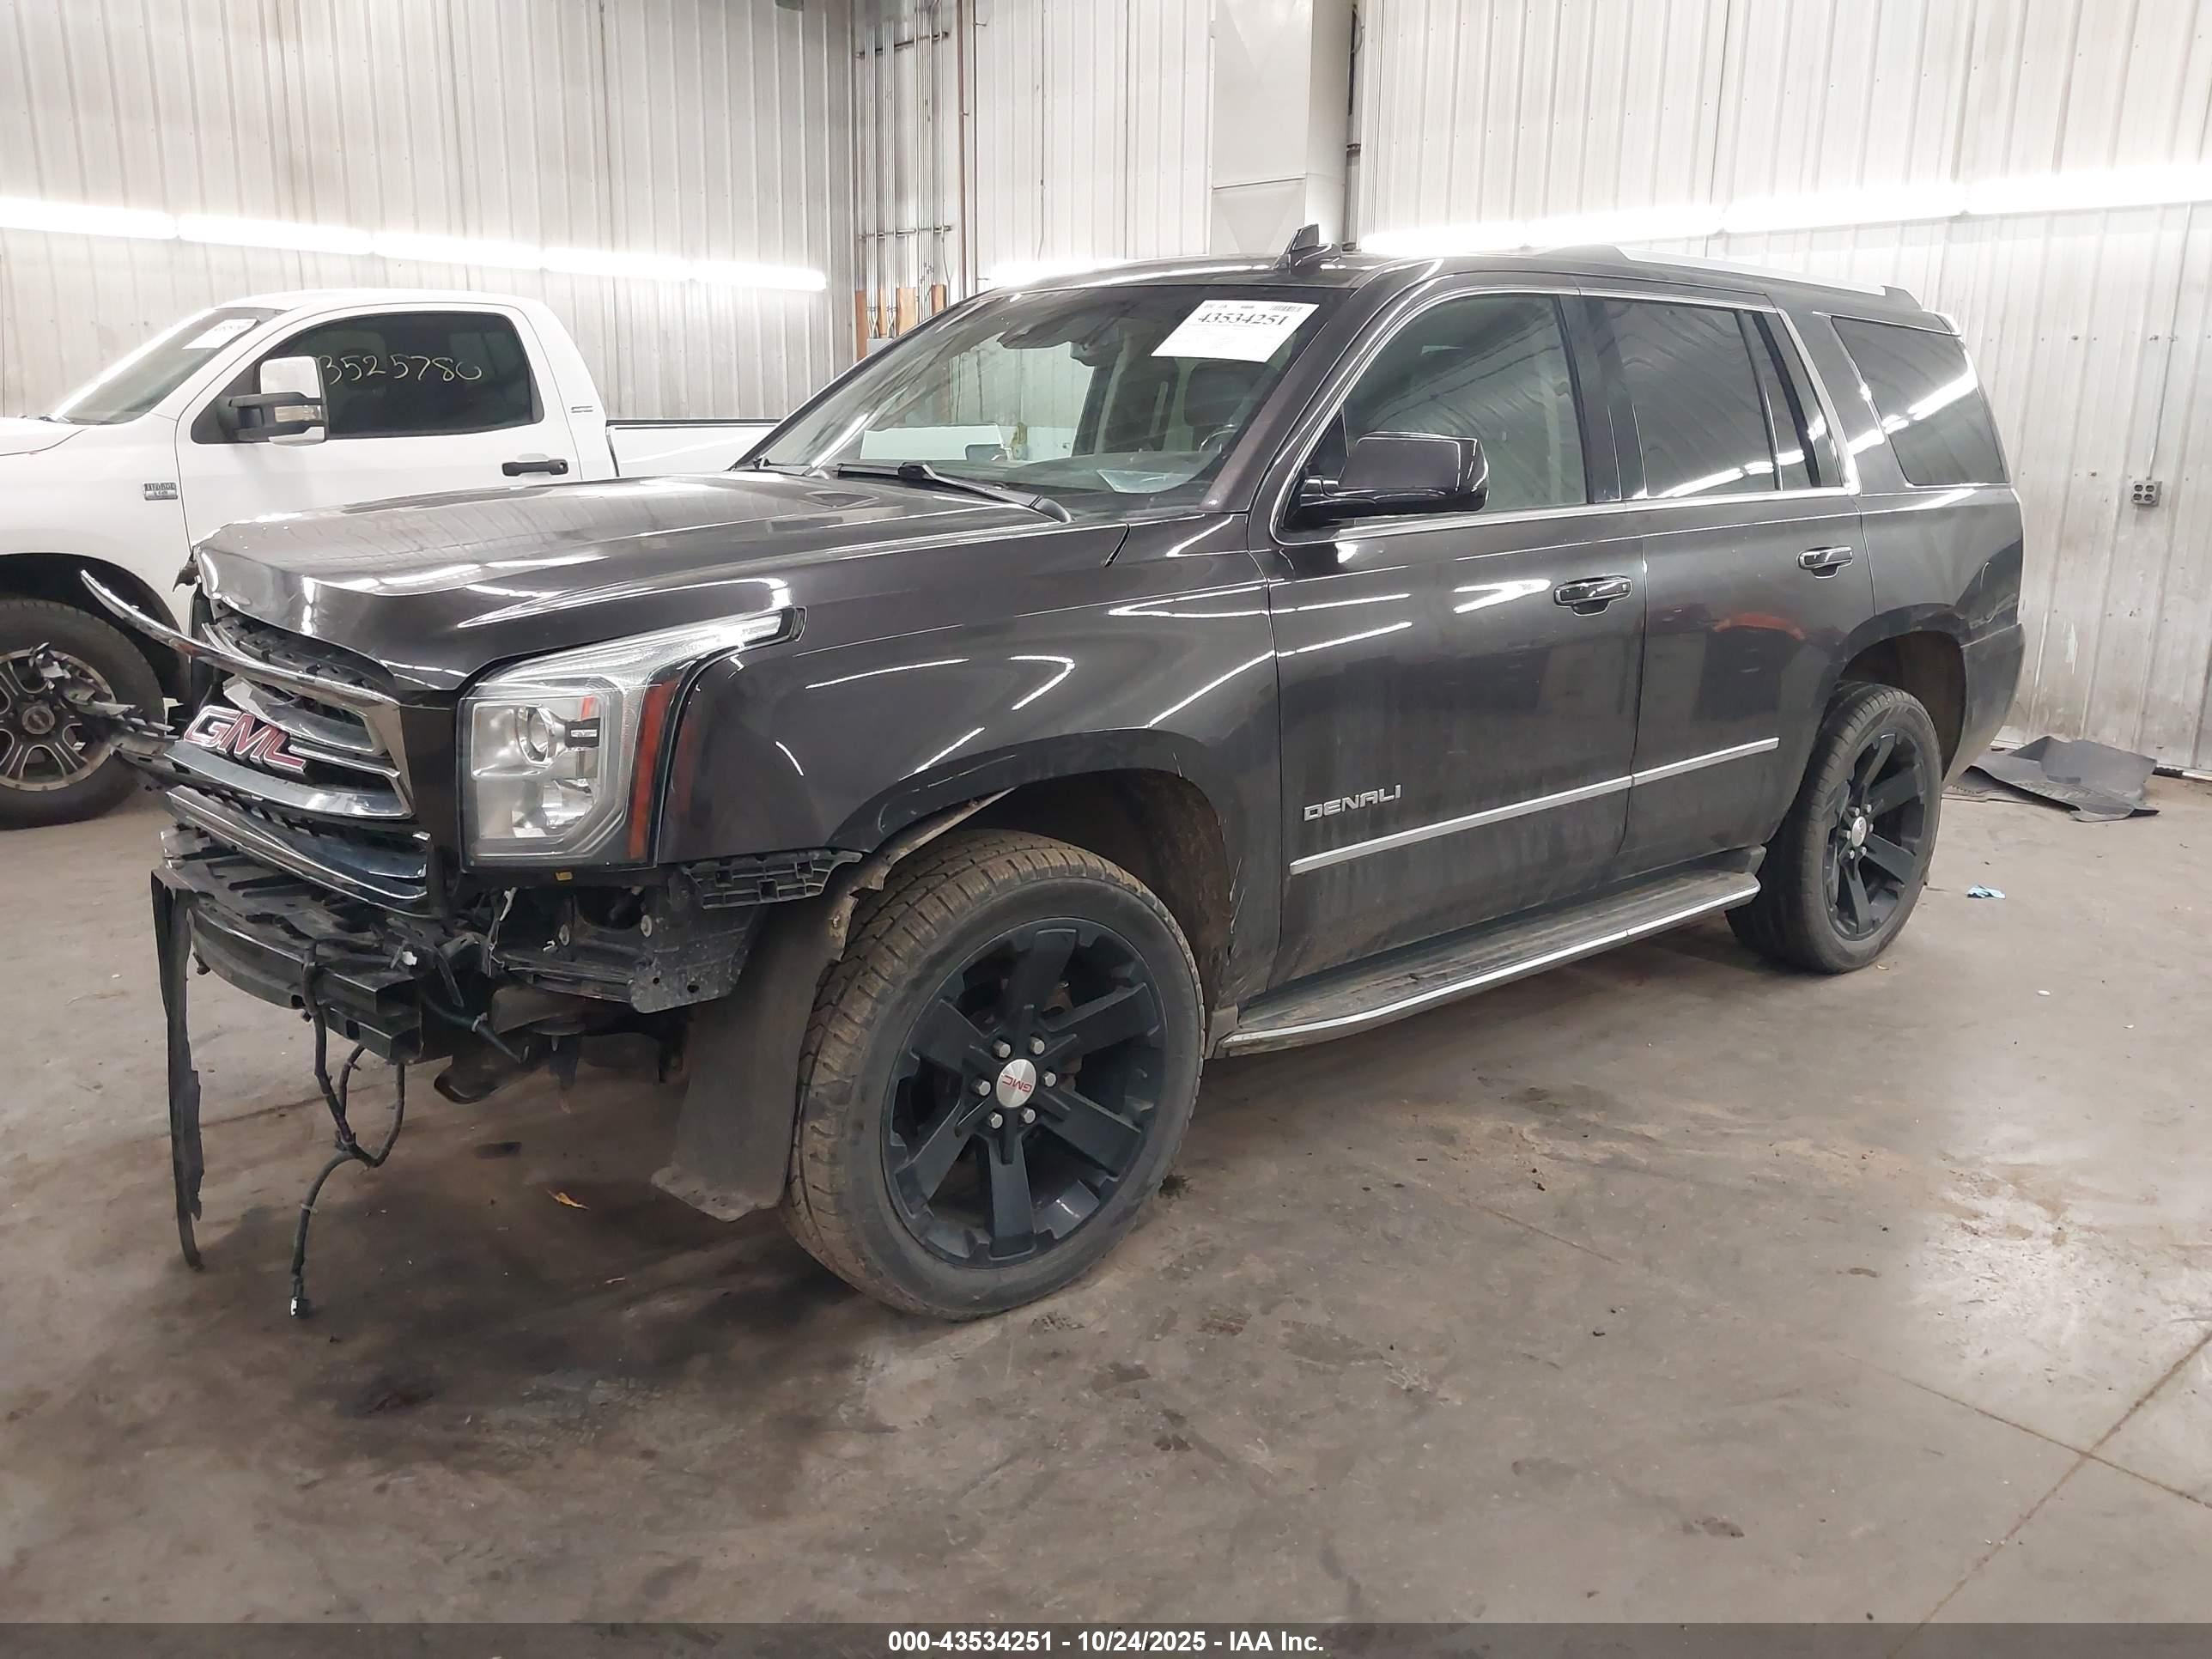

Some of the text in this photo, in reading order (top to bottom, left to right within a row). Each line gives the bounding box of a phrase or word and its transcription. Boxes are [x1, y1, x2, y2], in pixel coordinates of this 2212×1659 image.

[1198, 313, 1289, 326] 43534251
[1304, 784, 1401, 822] DENALI
[1002, 1074, 1032, 1093] GMC
